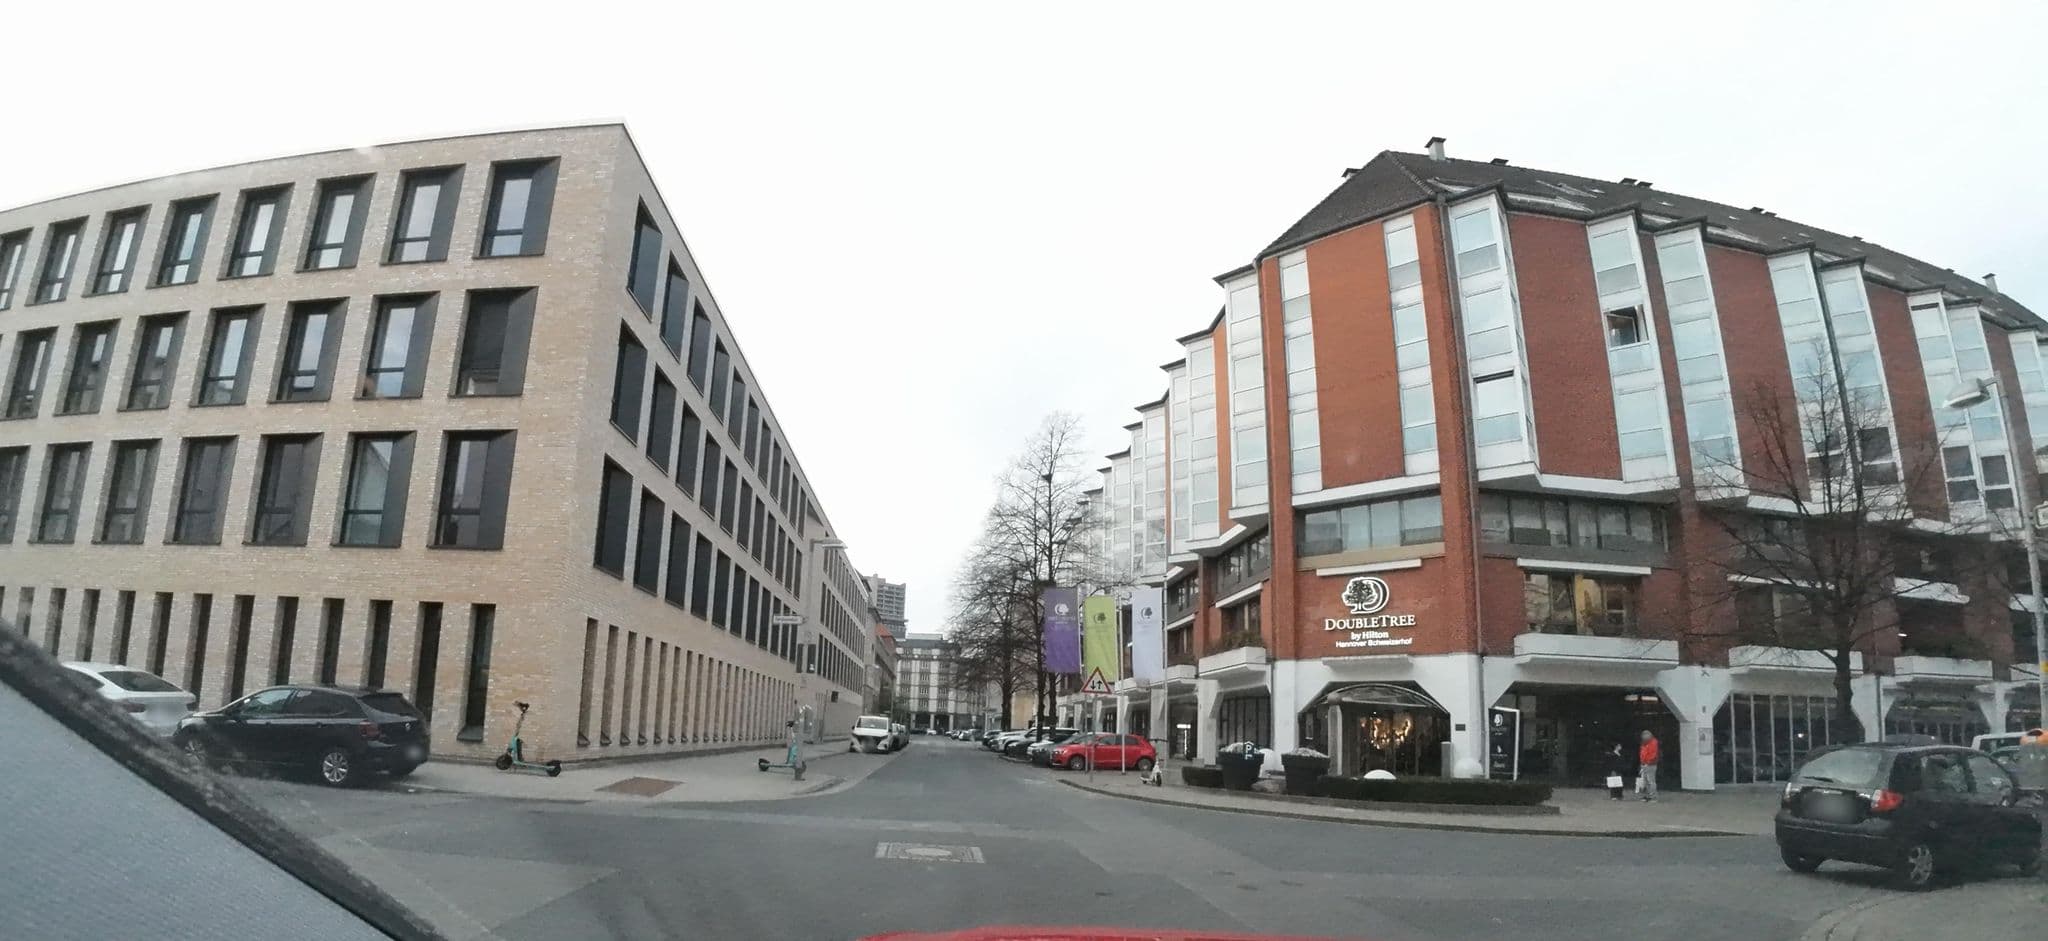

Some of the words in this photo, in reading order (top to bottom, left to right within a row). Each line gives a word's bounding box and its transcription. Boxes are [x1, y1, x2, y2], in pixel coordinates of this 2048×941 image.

[1324, 614, 1416, 631] DOUBLETREE
[1350, 631, 1361, 641] by
[1362, 631, 1390, 640] Hilton
[1335, 640, 1367, 648] Hannover
